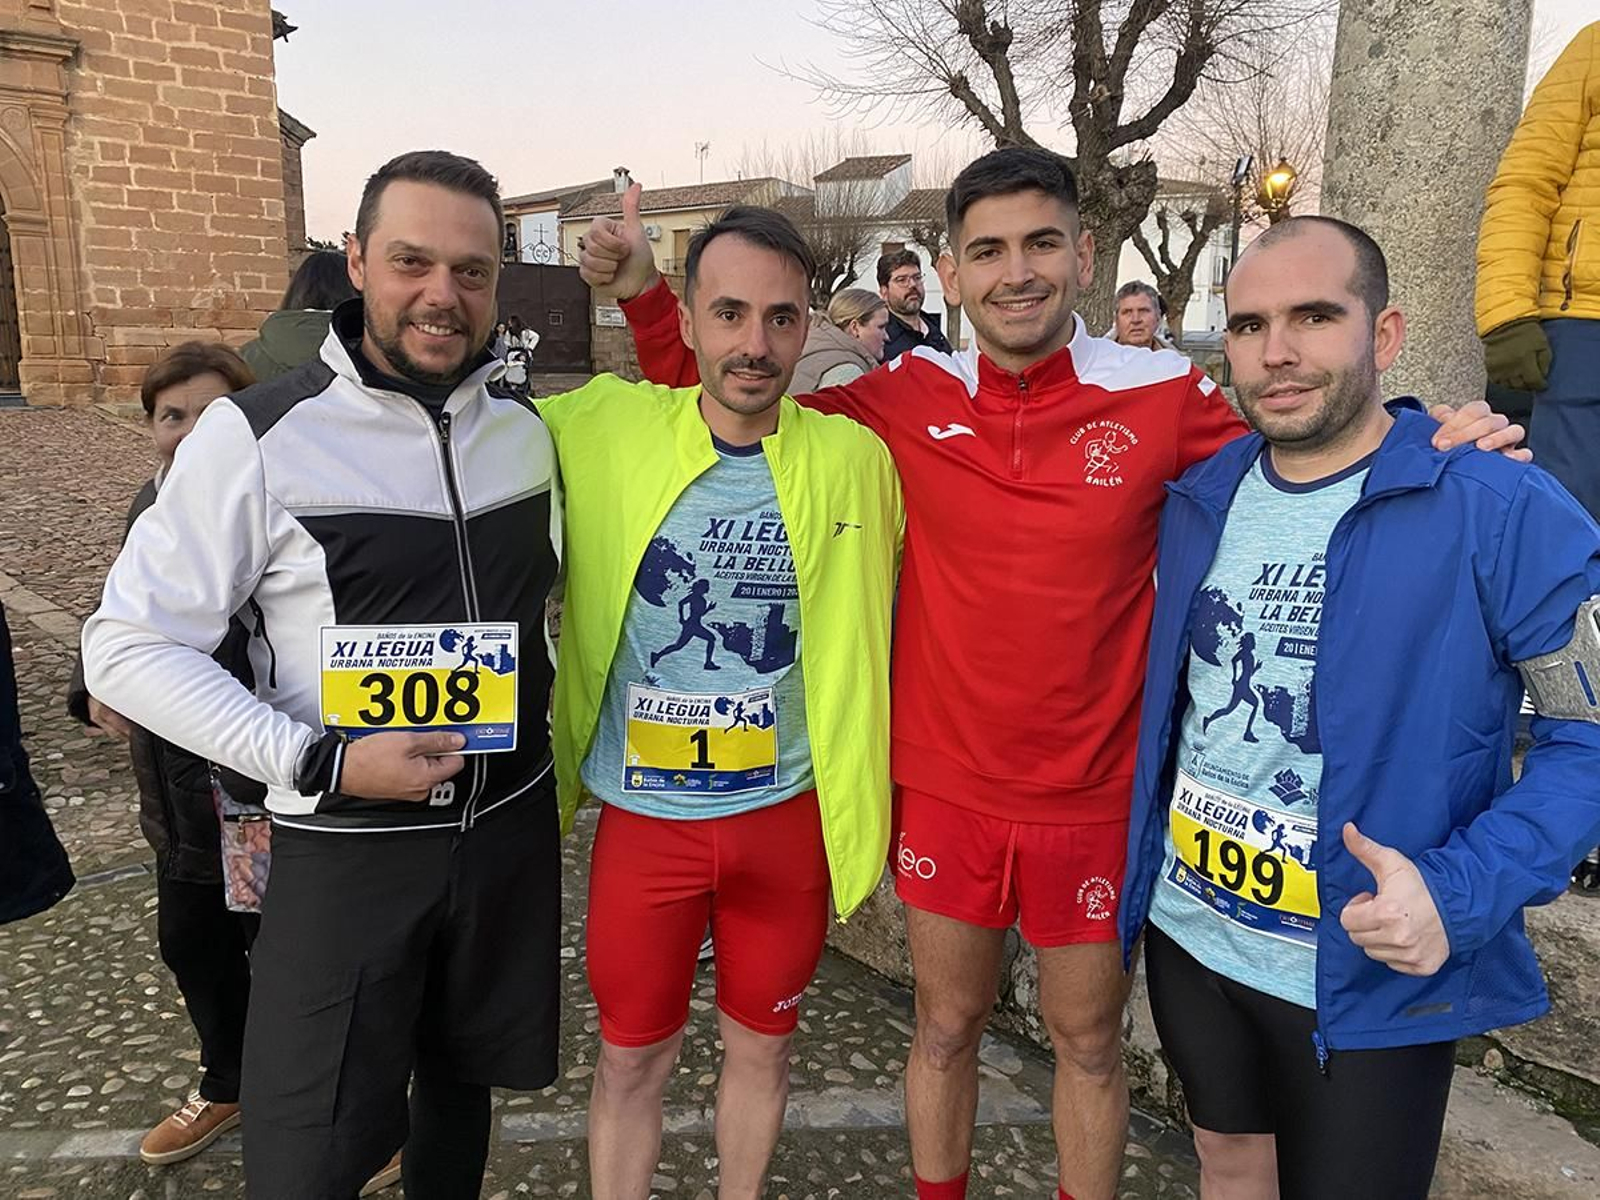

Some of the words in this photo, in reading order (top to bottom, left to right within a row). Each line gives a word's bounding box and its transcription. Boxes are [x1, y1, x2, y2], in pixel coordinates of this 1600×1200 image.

[1070, 427, 1086, 445] CLUB
[1086, 421, 1098, 430] DE
[1099, 420, 1139, 445] ATLETISMO
[1085, 475, 1123, 487] BAILÉN
[701, 518, 736, 540] XI
[699, 540, 752, 555] URBANA
[713, 555, 737, 569] LA
[714, 571, 746, 580] ACEITES
[1251, 563, 1287, 586] XI
[1289, 564, 1327, 588] LE
[1248, 588, 1299, 603] URBANA
[1302, 591, 1325, 604] NO
[1259, 604, 1282, 620] LA
[377, 632, 397, 640] BAÑOS
[1259, 622, 1289, 633] ACEITES
[331, 642, 358, 658] XI
[363, 640, 434, 657] LEGUA
[330, 659, 373, 669] URBANA
[377, 658, 433, 667] NOCTURNA
[358, 670, 481, 726] 308
[634, 697, 653, 712] XI
[657, 700, 711, 718] LEGUA
[633, 711, 664, 722] URBANA
[666, 716, 710, 725] NOCTURNA
[690, 729, 716, 769] 1
[1179, 787, 1193, 806] XI
[1195, 797, 1249, 830] LEGUA
[1177, 802, 1201, 821] URBANA
[1203, 816, 1245, 840] NOCTURNA
[1194, 828, 1284, 906] 199
